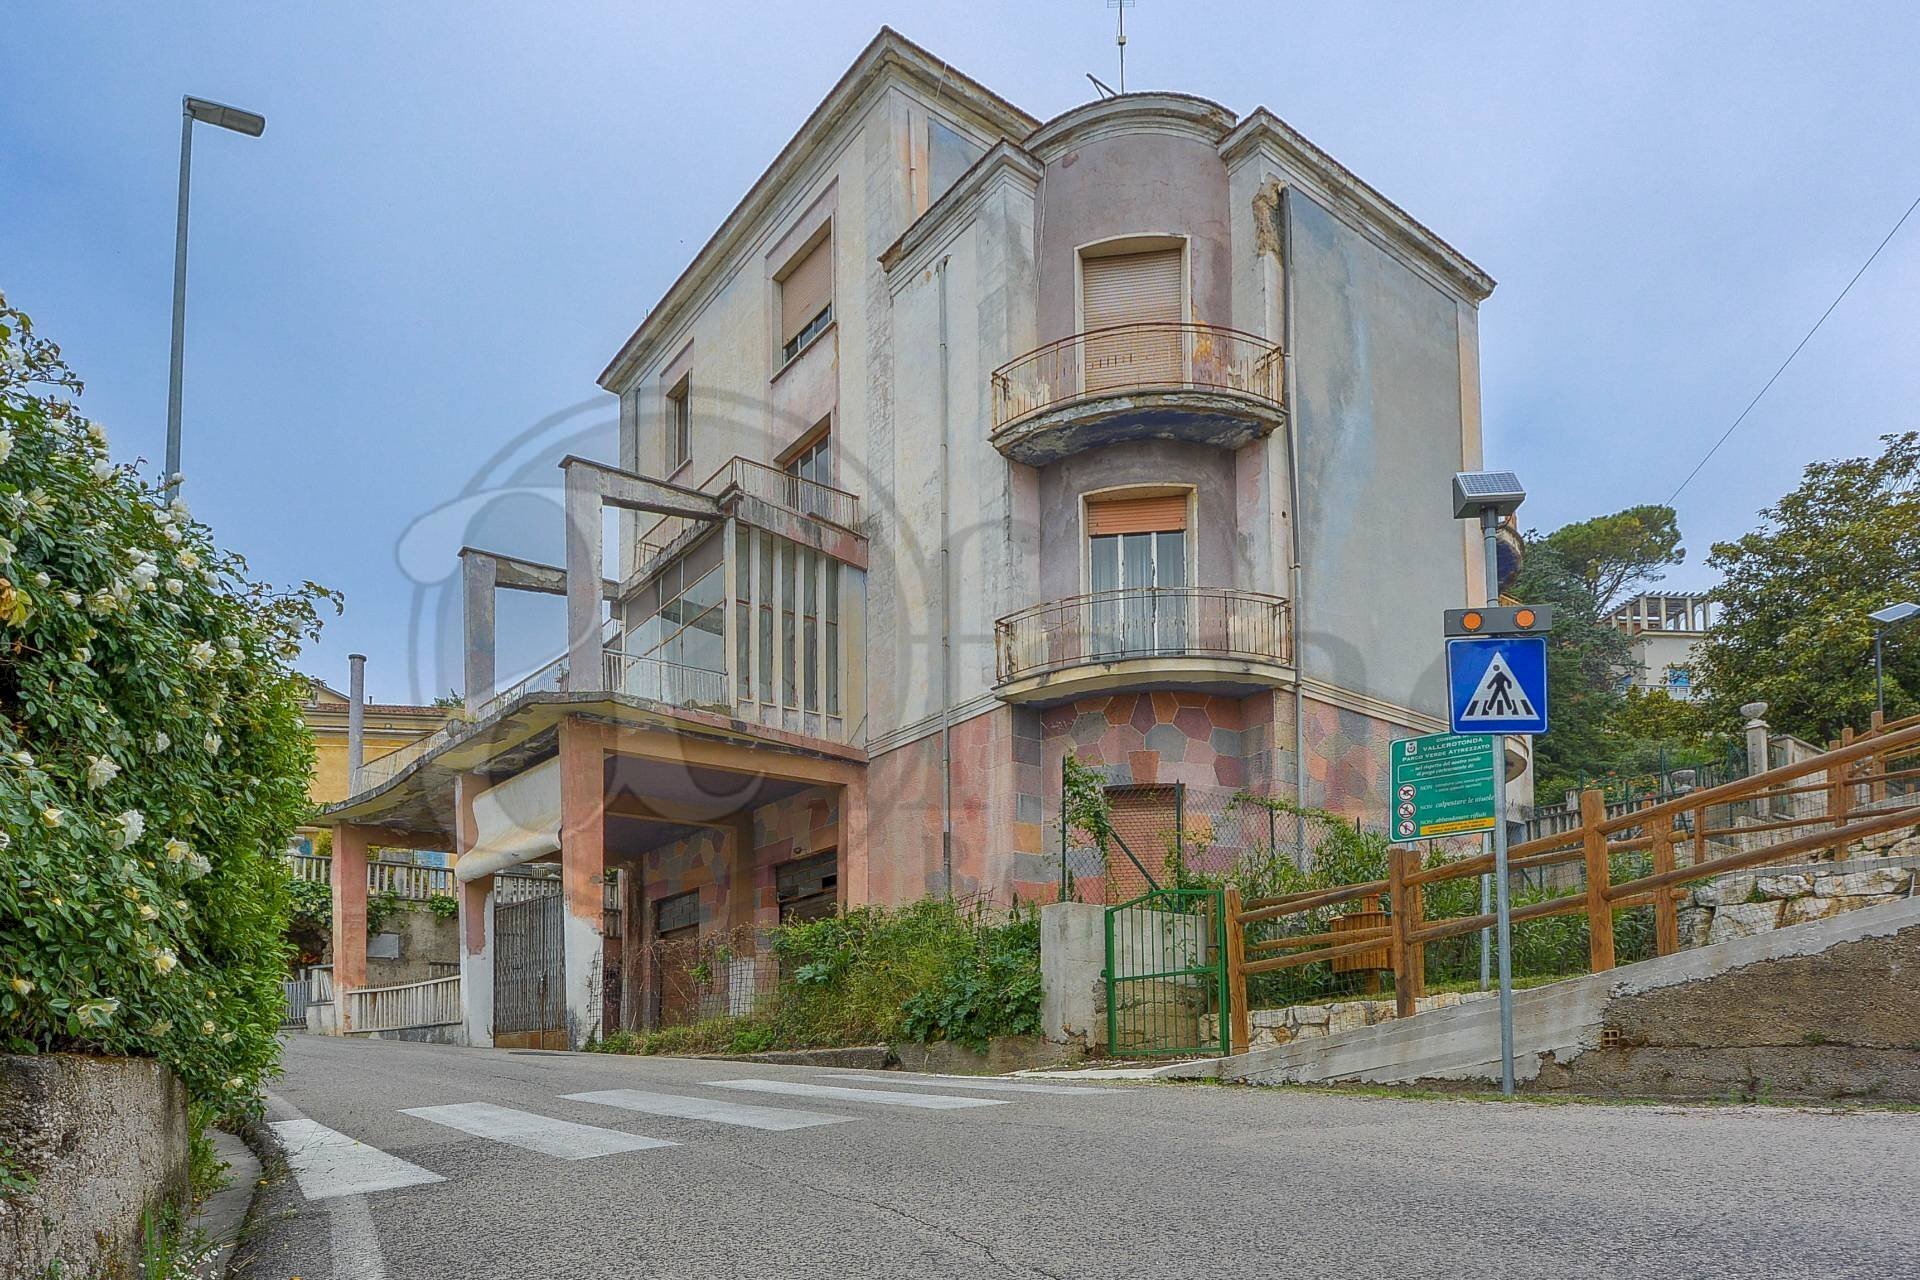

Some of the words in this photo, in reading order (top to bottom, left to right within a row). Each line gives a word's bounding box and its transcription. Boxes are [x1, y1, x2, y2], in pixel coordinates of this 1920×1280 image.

[1423, 737, 1483, 751] VALLEROTONDA
[1448, 744, 1490, 755] ATTREZZATO
[1436, 798, 1467, 809] calpestare
[1475, 794, 1495, 803] aiuole
[1435, 814, 1469, 823] abbandonare
[1470, 811, 1487, 819] rifiuti
